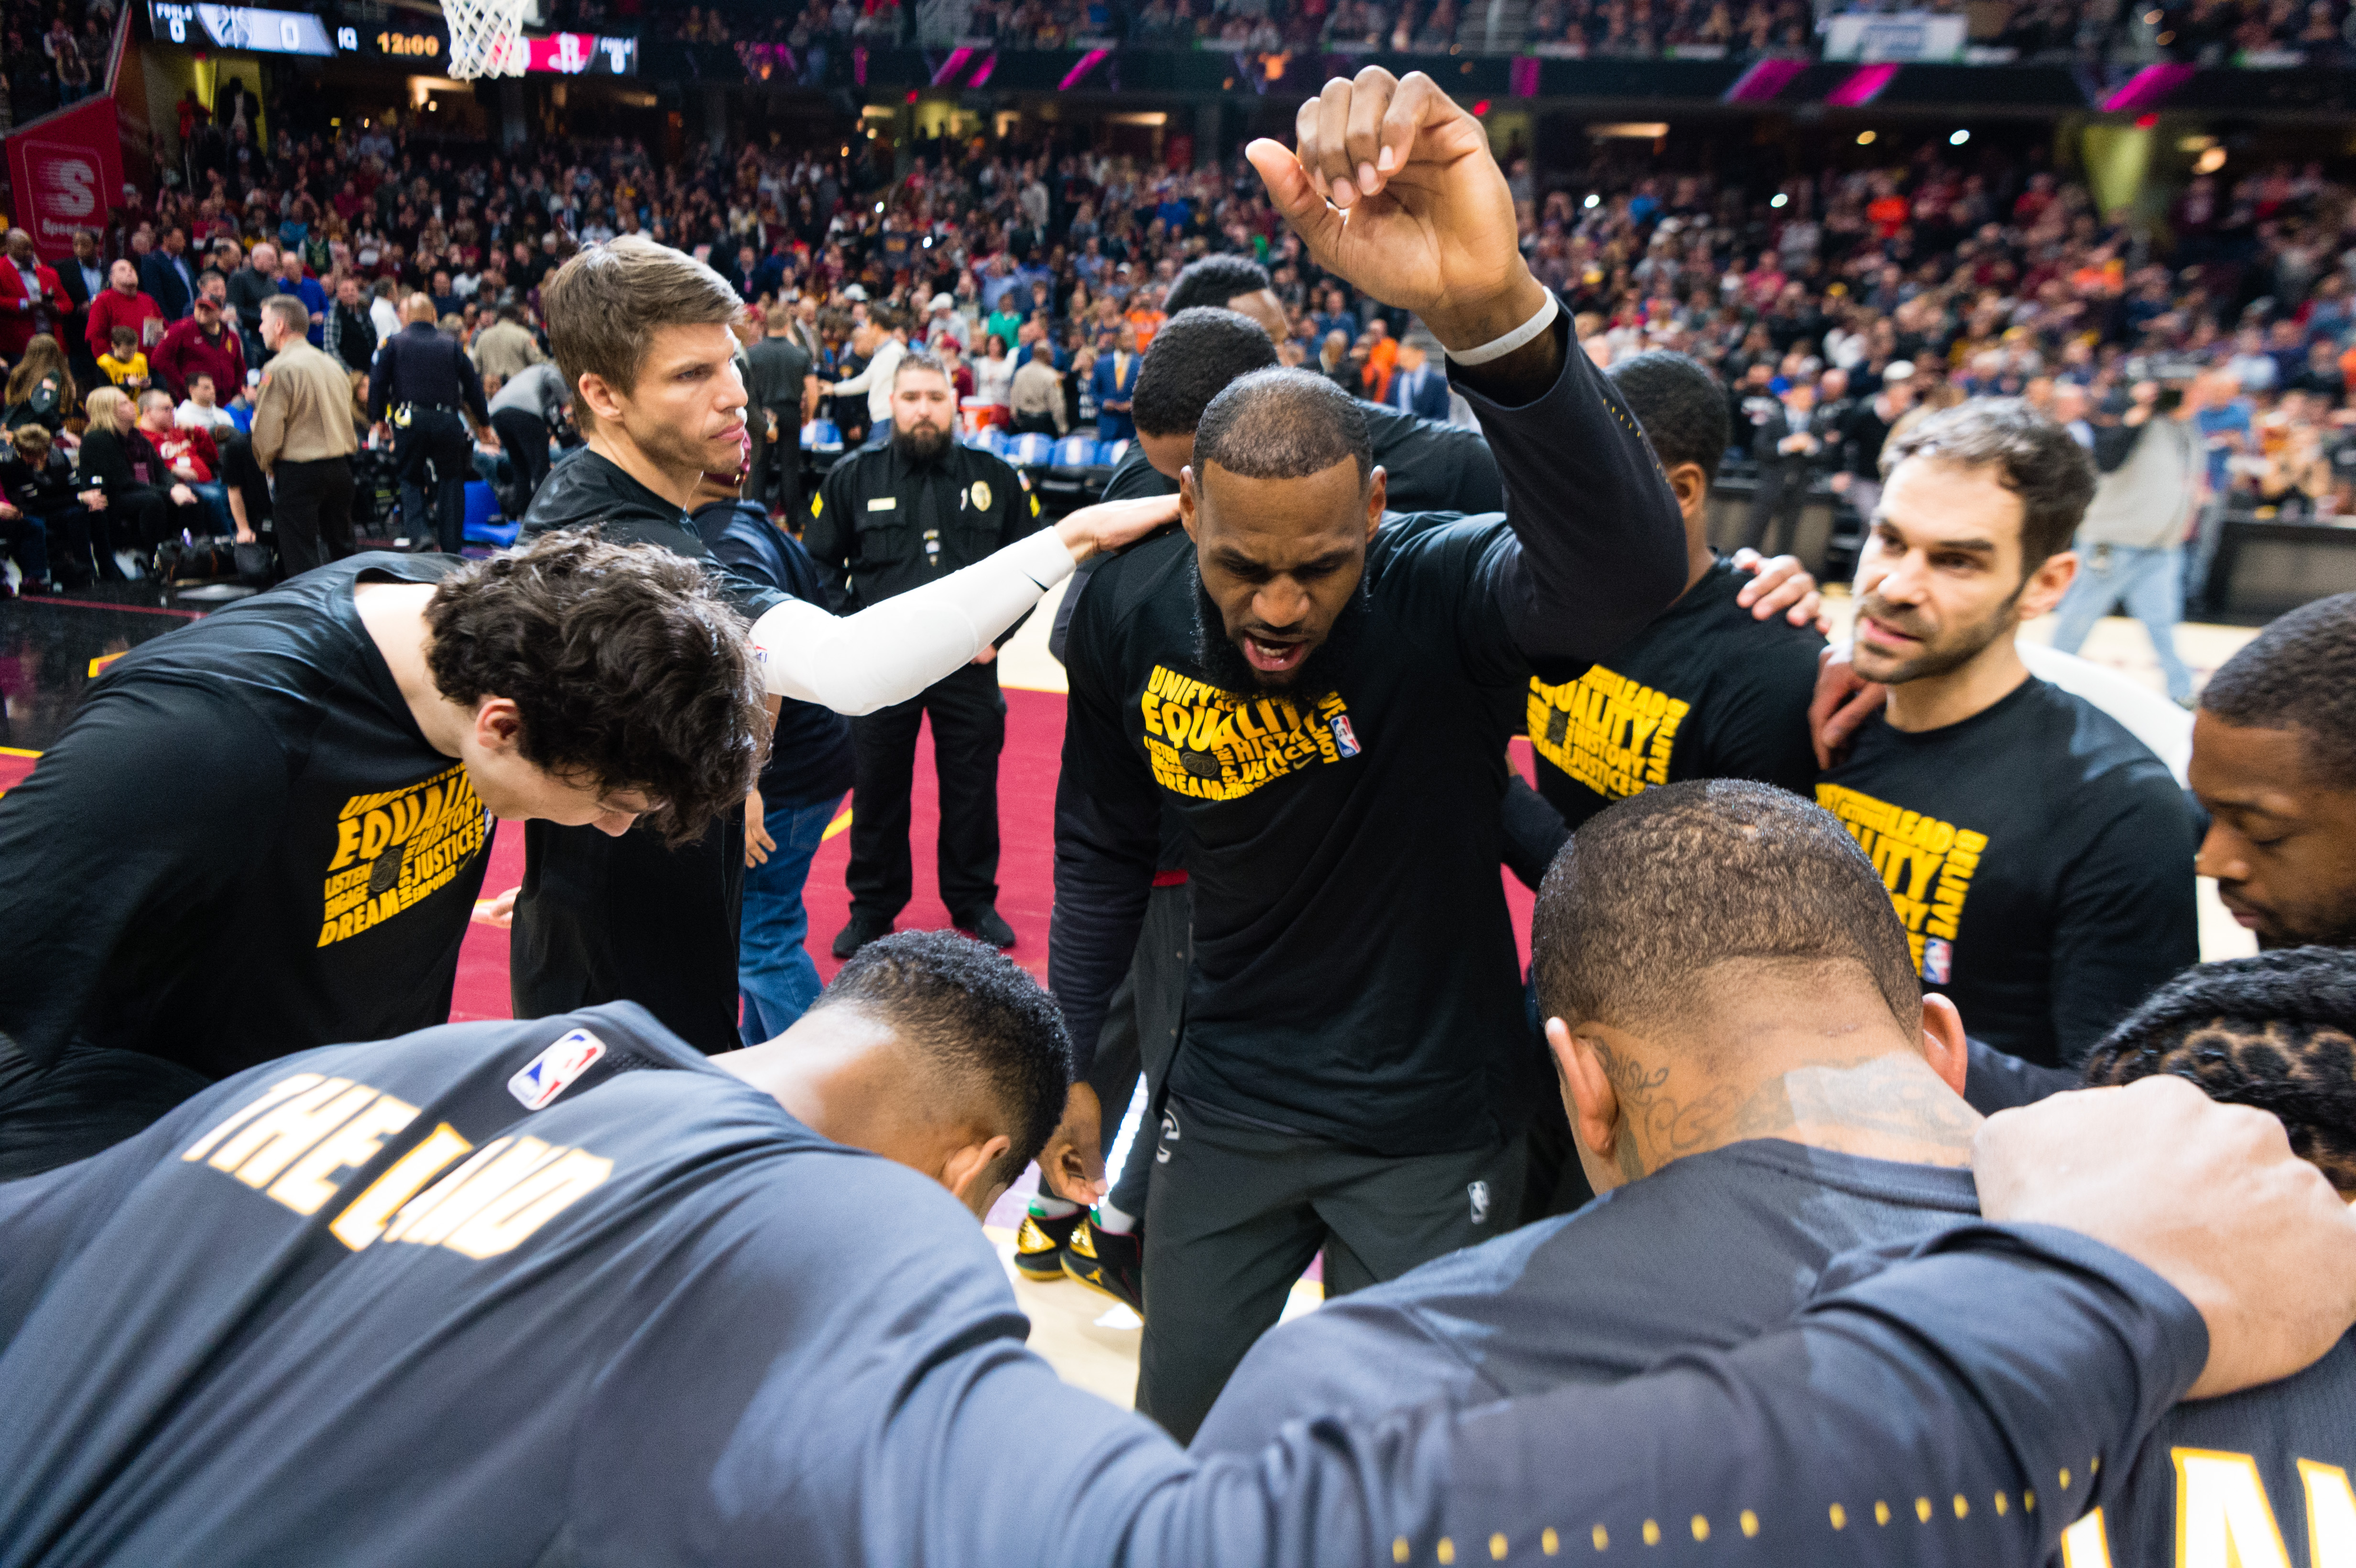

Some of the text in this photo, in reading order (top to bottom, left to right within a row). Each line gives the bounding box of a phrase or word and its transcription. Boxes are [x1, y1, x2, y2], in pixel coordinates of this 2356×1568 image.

[170, 19, 185, 43] 0
[377, 32, 439, 57] 12:00
[1148, 664, 1215, 707] UNIFY
[1611, 676, 1669, 719] LEAD
[1573, 722, 1646, 780] HISTORY
[1151, 765, 1224, 801] DREAM
[1884, 806, 1956, 854] LEAD
[412, 821, 475, 887] JUSTICE
[325, 861, 374, 900] LISTEN
[316, 888, 400, 947] DREAM
[181, 1073, 421, 1216] THE
